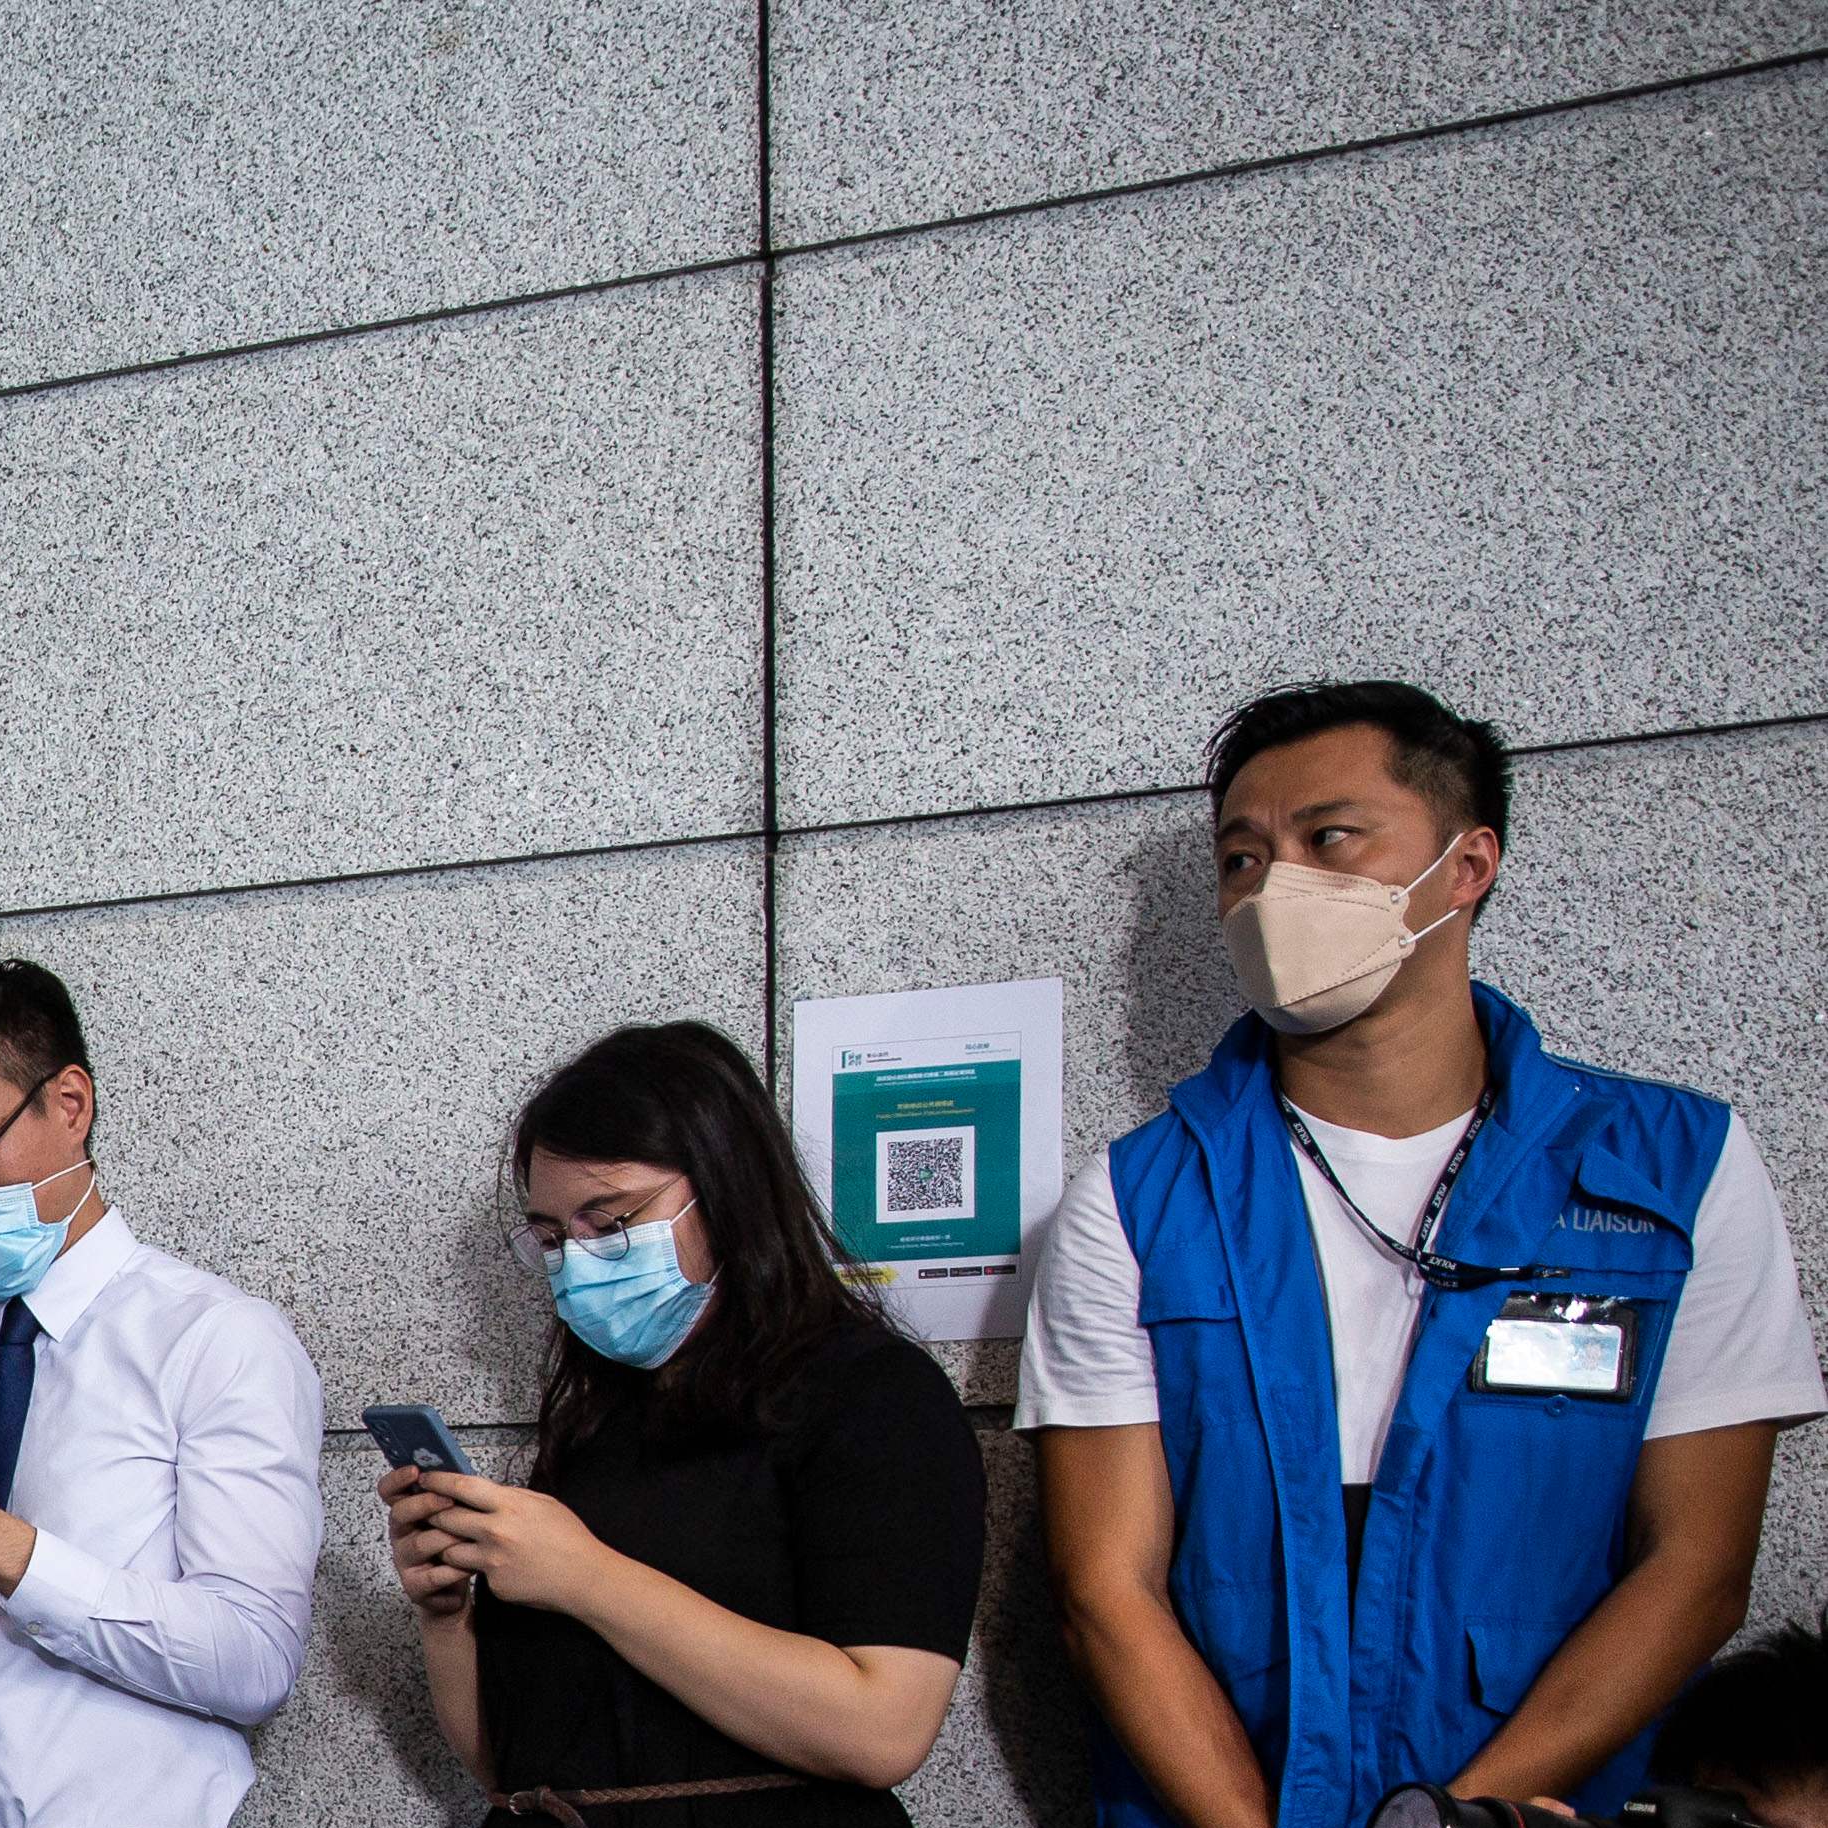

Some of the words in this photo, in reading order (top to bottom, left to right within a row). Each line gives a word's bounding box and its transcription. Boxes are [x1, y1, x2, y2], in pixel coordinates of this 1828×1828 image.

[1447, 1149, 1466, 1175] POLICE
[1432, 1183, 1449, 1209] POLICE
[1572, 1207, 1656, 1233] LIAISON
